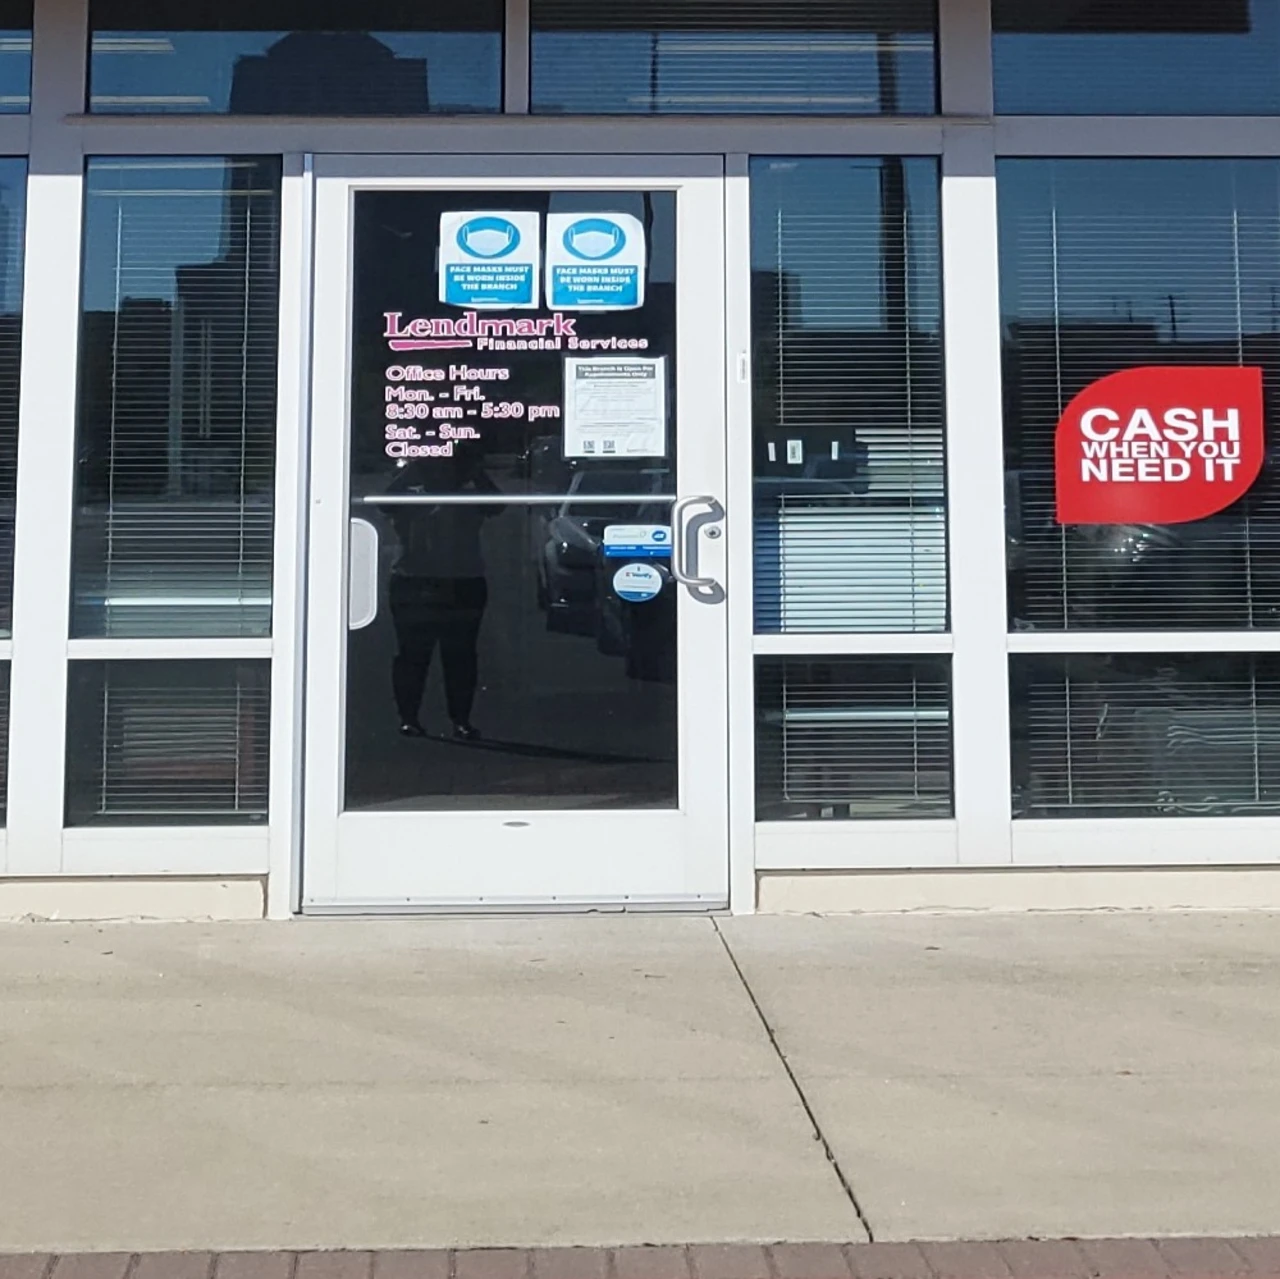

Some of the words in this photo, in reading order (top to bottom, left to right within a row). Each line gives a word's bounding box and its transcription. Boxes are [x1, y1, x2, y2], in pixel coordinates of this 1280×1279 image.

[450, 265, 471, 273] FACE
[473, 265, 503, 273] MASKS
[504, 265, 529, 273] MUST
[556, 267, 577, 275] FACE
[610, 267, 635, 275] MUST
[495, 274, 526, 282] INSIDE
[461, 283, 479, 291] THE
[480, 283, 518, 291] BRANCH
[568, 284, 585, 292] THE
[586, 284, 623, 292] BRANCH
[383, 311, 577, 338] Lendmark
[476, 336, 562, 351] Financial
[567, 336, 649, 350] Services
[385, 365, 446, 381] Office
[448, 365, 510, 381] Hours
[385, 386, 435, 402] Mon.
[453, 386, 486, 402] Fri.
[385, 404, 429, 419] 8:30
[432, 407, 463, 419] am
[480, 403, 524, 418] 5:30
[528, 405, 560, 422] pm
[385, 424, 422, 440] Sat.
[438, 424, 481, 440] Sun.
[1079, 407, 1240, 442] CASH
[385, 442, 454, 457] Closed
[1081, 441, 1169, 458] WHEN
[1177, 441, 1241, 458] YOU
[1081, 459, 1192, 482] NEED
[1204, 459, 1241, 482] IT
